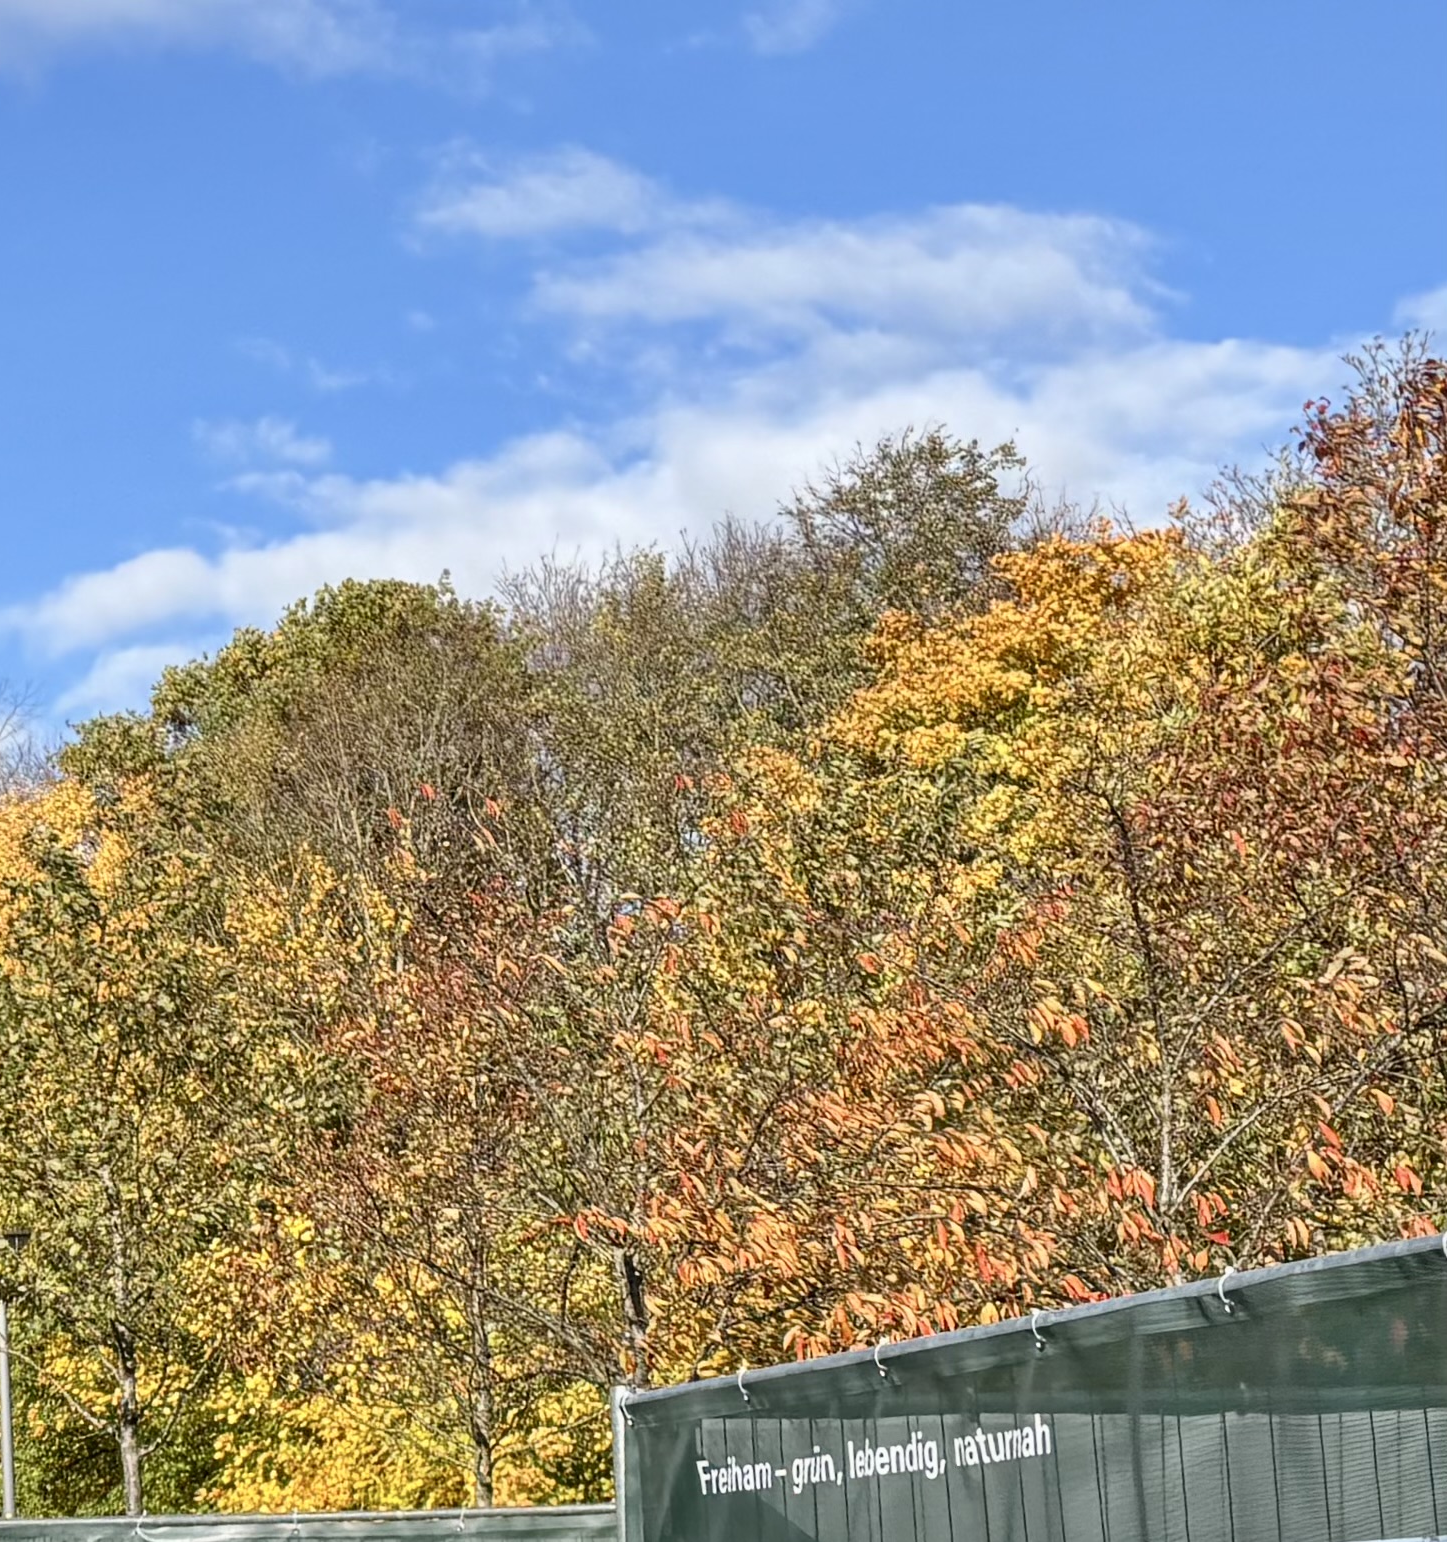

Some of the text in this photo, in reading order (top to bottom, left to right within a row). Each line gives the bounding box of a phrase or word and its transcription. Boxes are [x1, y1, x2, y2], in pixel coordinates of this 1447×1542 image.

[696, 1456, 773, 1495] Freiham
[792, 1445, 843, 1495] grün,
[847, 1431, 947, 1480] lebendig,
[954, 1413, 1051, 1469] naturnah
